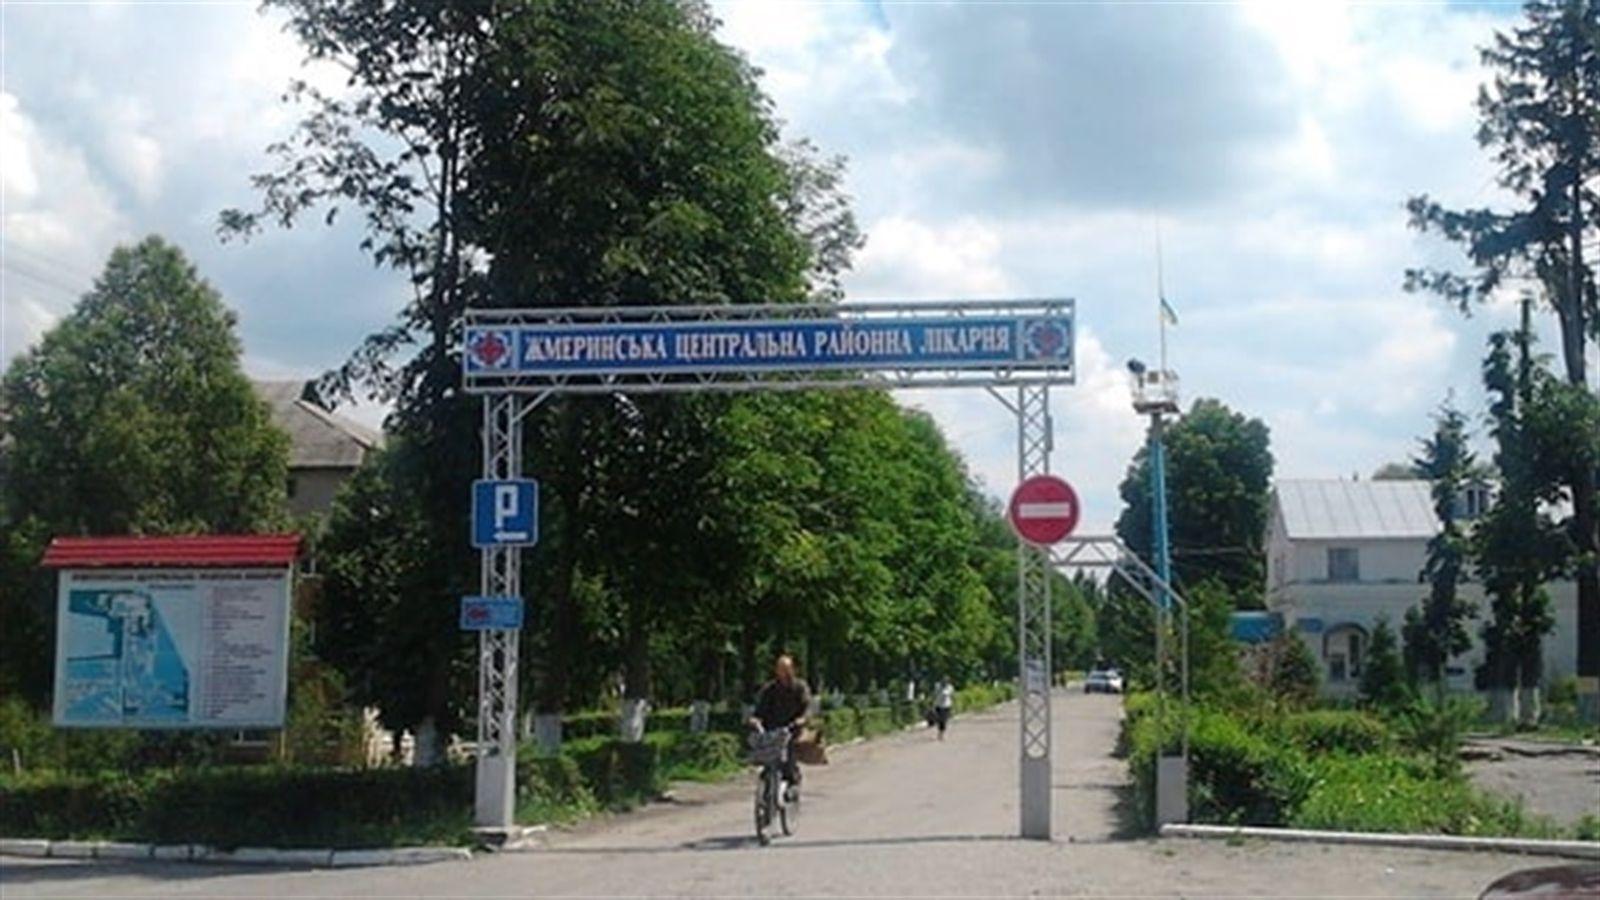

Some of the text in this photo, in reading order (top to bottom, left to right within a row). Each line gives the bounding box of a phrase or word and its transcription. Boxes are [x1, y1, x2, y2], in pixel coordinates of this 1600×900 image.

[525, 324, 1009, 362] ЖМЕРИНСЬКА ЦЕНТРАЛЬНА РАЙОННА ЛІКАРНЯ
[495, 484, 519, 528] P
